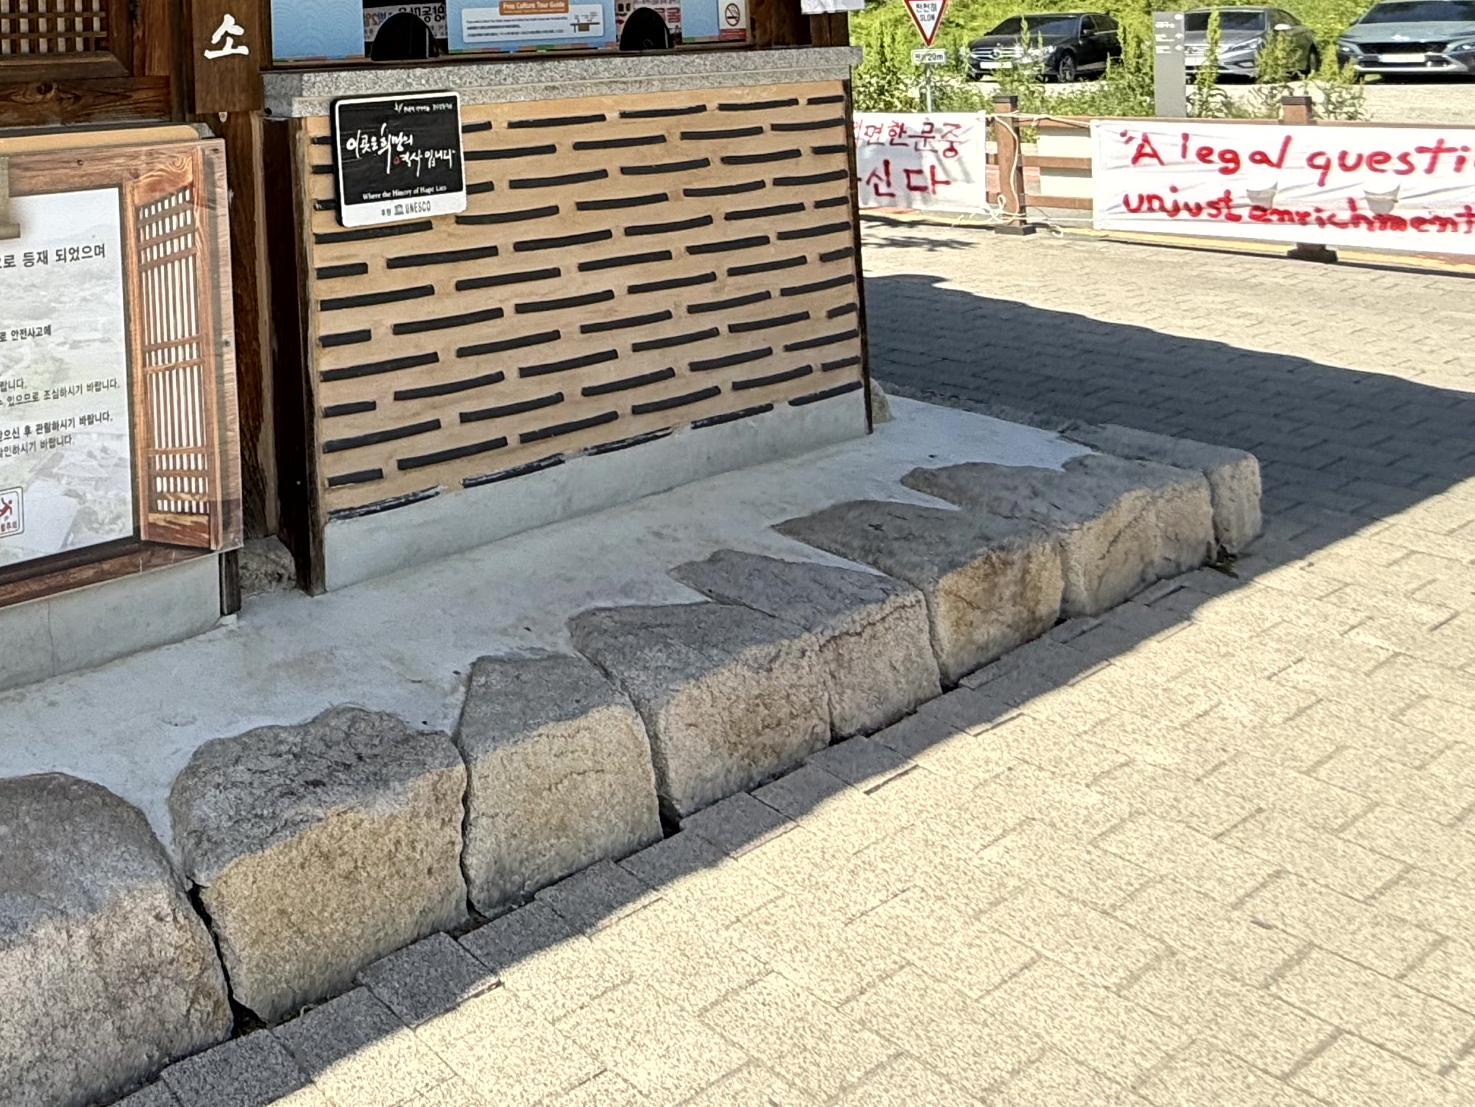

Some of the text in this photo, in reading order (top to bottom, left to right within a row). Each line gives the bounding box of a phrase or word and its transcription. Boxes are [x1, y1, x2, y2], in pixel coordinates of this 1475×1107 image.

[916, 3, 937, 13] 천천히
[928, 53, 943, 61] 20m
[1181, 133, 1293, 175] legal
[1305, 138, 1475, 187] questi
[405, 201, 431, 213] UNESCO
[1123, 186, 1242, 222] unjust
[21, 249, 48, 268] 등재
[54, 242, 105, 263] 되었으며
[10, 323, 52, 341] 안전사고에
